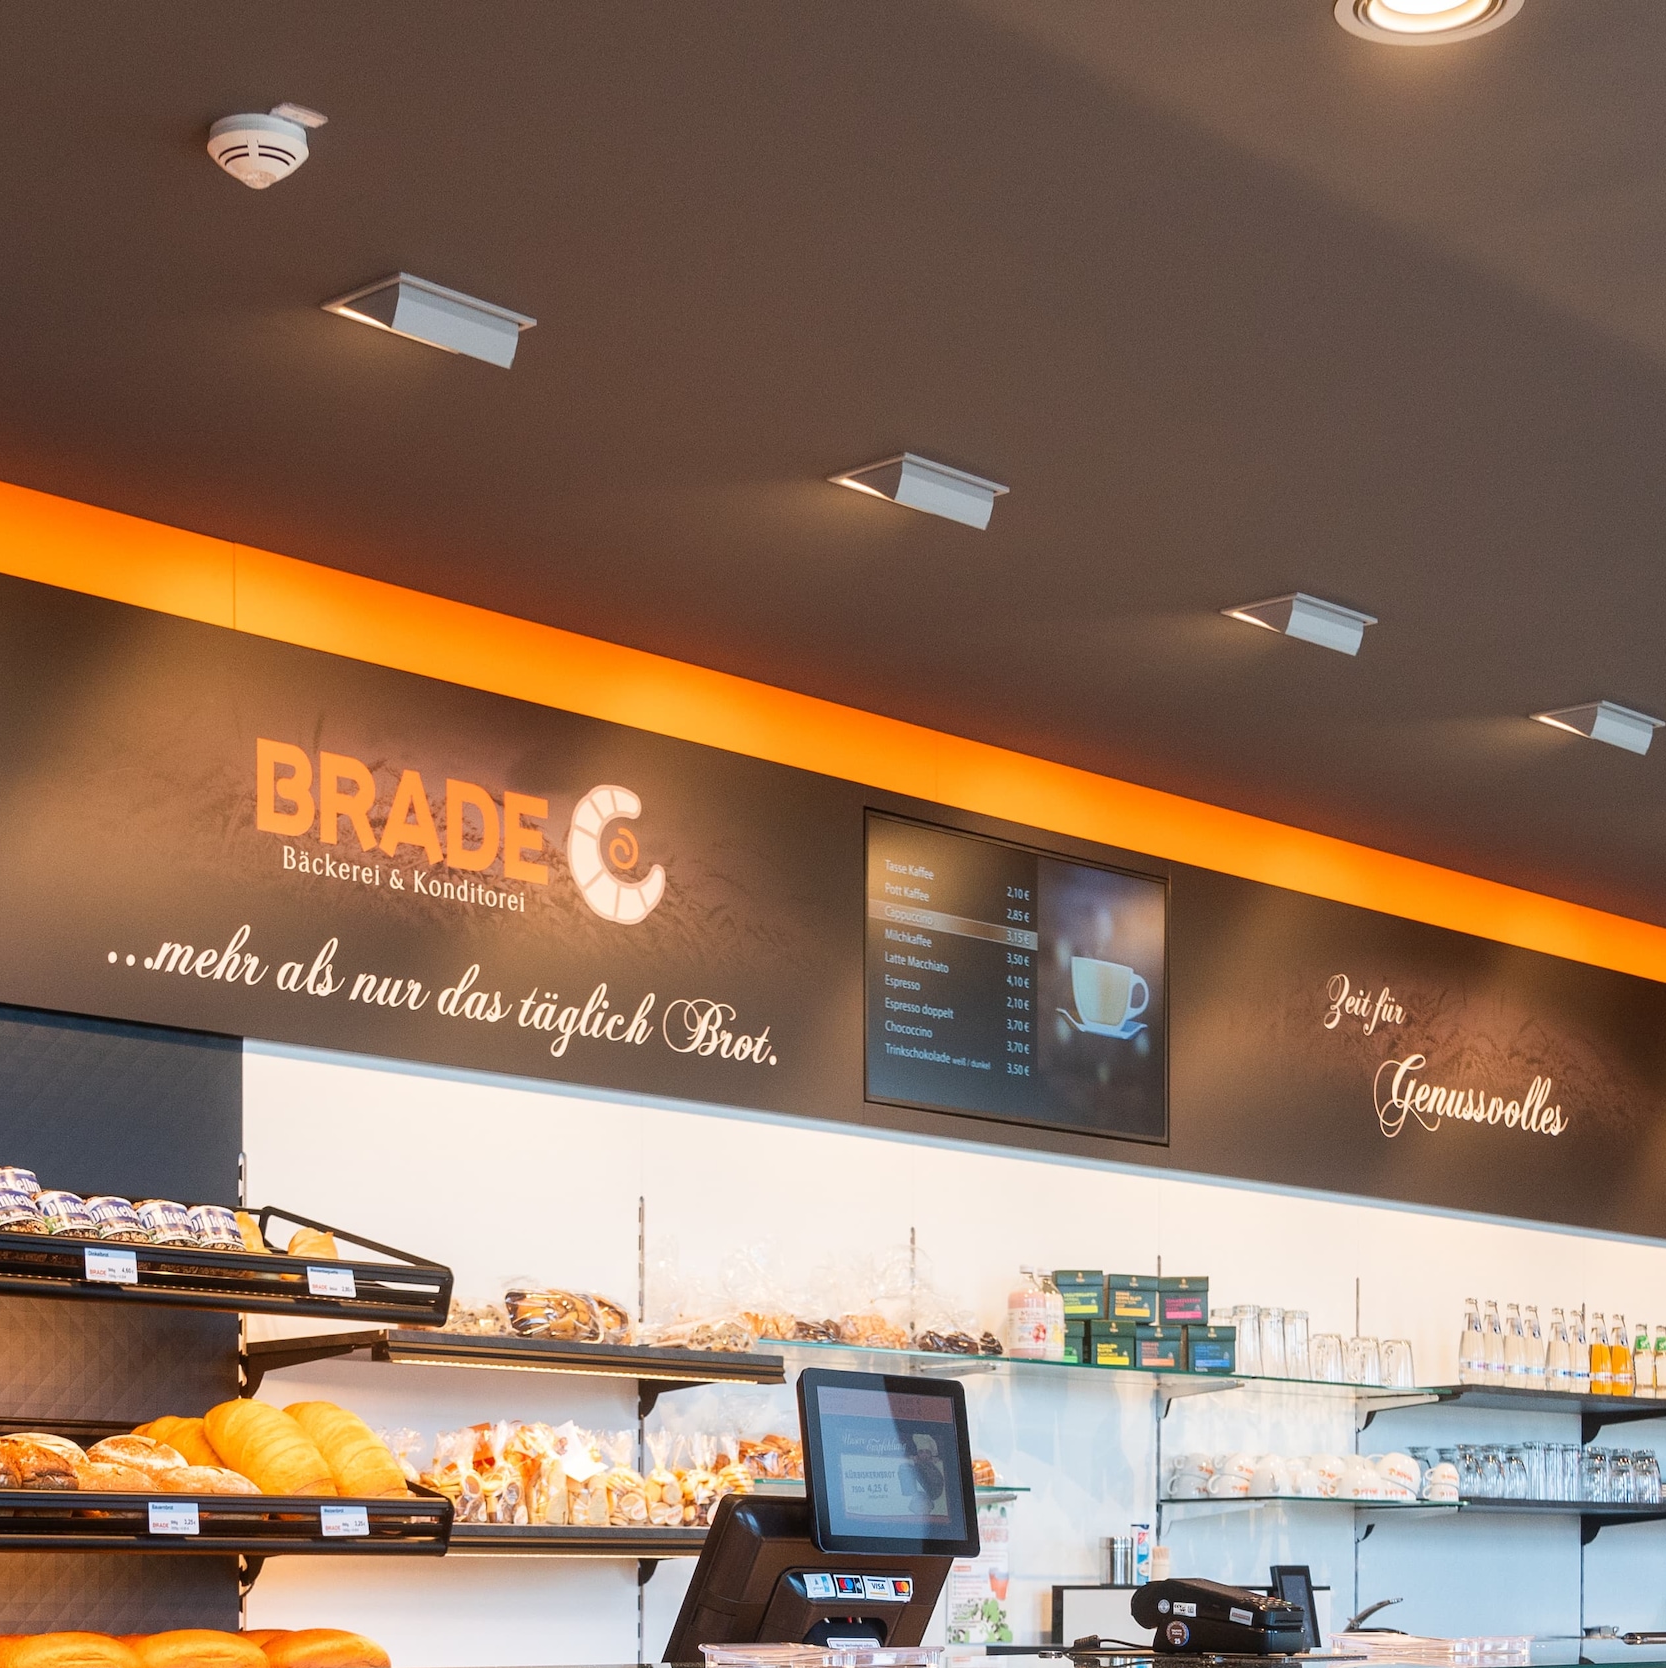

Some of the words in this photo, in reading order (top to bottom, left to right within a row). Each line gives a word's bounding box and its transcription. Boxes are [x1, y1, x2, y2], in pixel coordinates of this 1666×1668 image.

[256, 737, 549, 885] BRADE
[282, 845, 381, 887] Bäckerei
[388, 867, 405, 891] &
[413, 868, 527, 913] Konditorei
[885, 859, 907, 876] Tasse
[908, 863, 934, 880] Kaffee
[885, 881, 900, 898] Pott
[901, 885, 930, 902] Kaffee
[885, 906, 933, 926] Cappuccino
[885, 928, 932, 948] Milchkaffee
[885, 951, 906, 967] Latte
[908, 955, 949, 974] Macchiato
[885, 974, 921, 992] Espresso
[275, 936, 344, 999] als
[349, 972, 431, 1013] nur
[437, 964, 513, 1025] das
[519, 983, 657, 1058] täglich
[662, 997, 779, 1065] Brot.
[885, 997, 921, 1014] Espresso
[922, 1001, 954, 1020] doppelt
[1323, 973, 1371, 1030] Zeit
[1365, 988, 1408, 1036] für
[885, 1020, 933, 1038] Chococcino
[885, 1043, 951, 1065] Trinkschokolade
[1374, 1053, 1568, 1139] Genussvolles
[89, 1268, 107, 1276] BRADE
[871, 1582, 885, 1590] VISA
